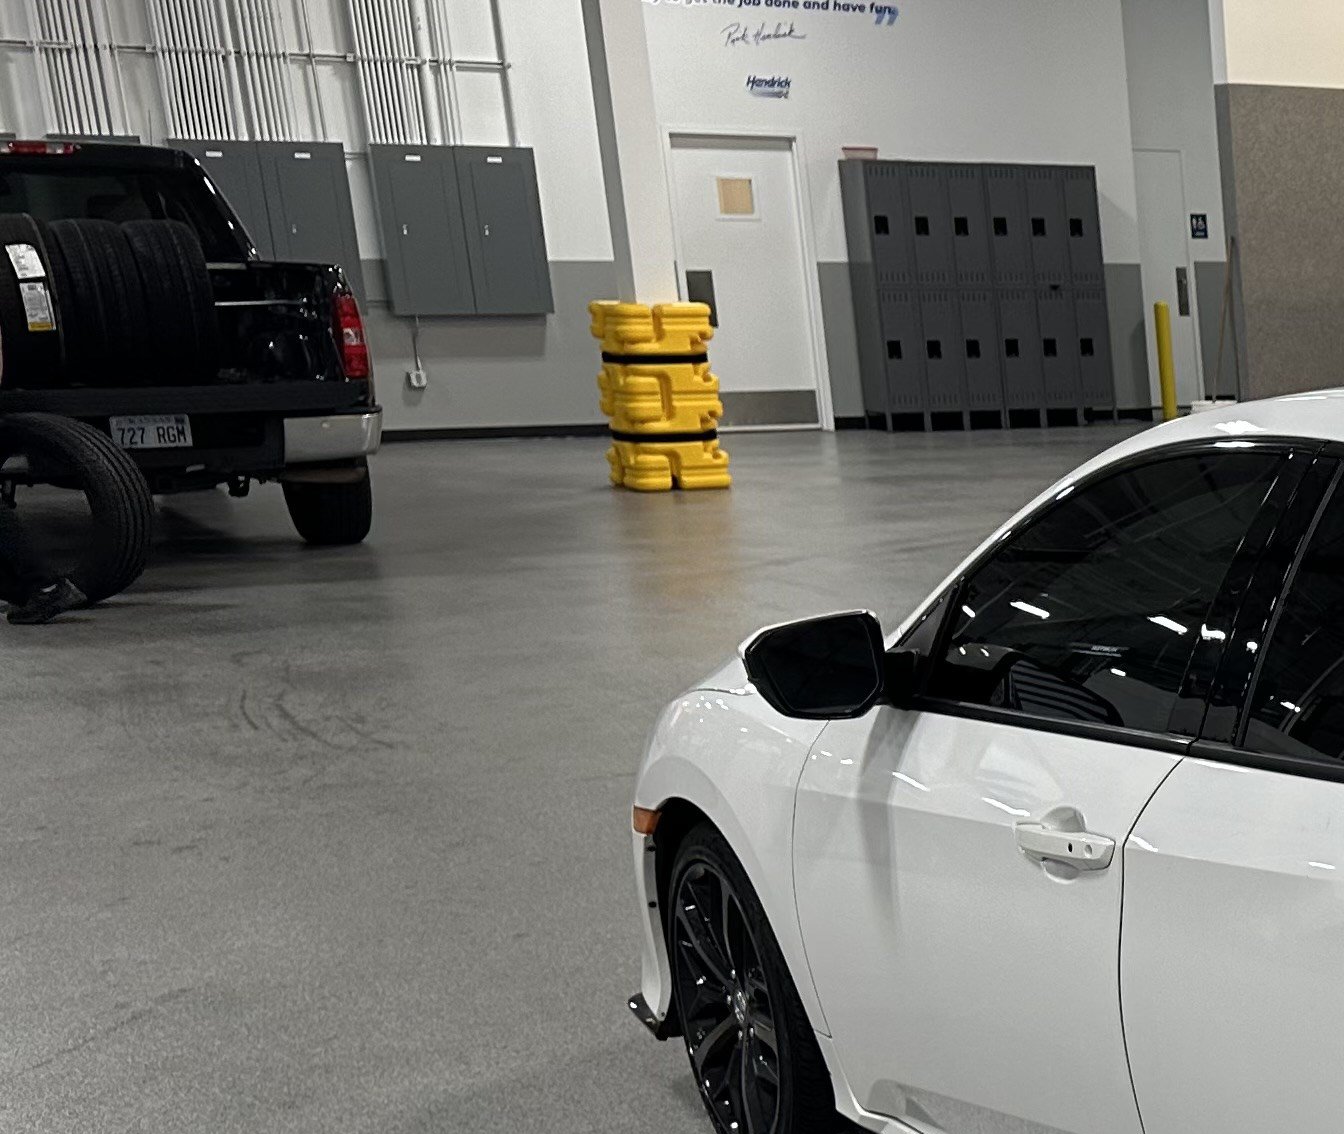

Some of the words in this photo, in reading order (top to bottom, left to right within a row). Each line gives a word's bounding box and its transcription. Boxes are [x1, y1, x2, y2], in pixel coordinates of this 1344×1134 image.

[803, 0, 829, 11] and
[833, 0, 866, 13] have
[746, 75, 791, 90] Hendrick
[117, 426, 146, 446] 727
[156, 425, 188, 444] RGM
